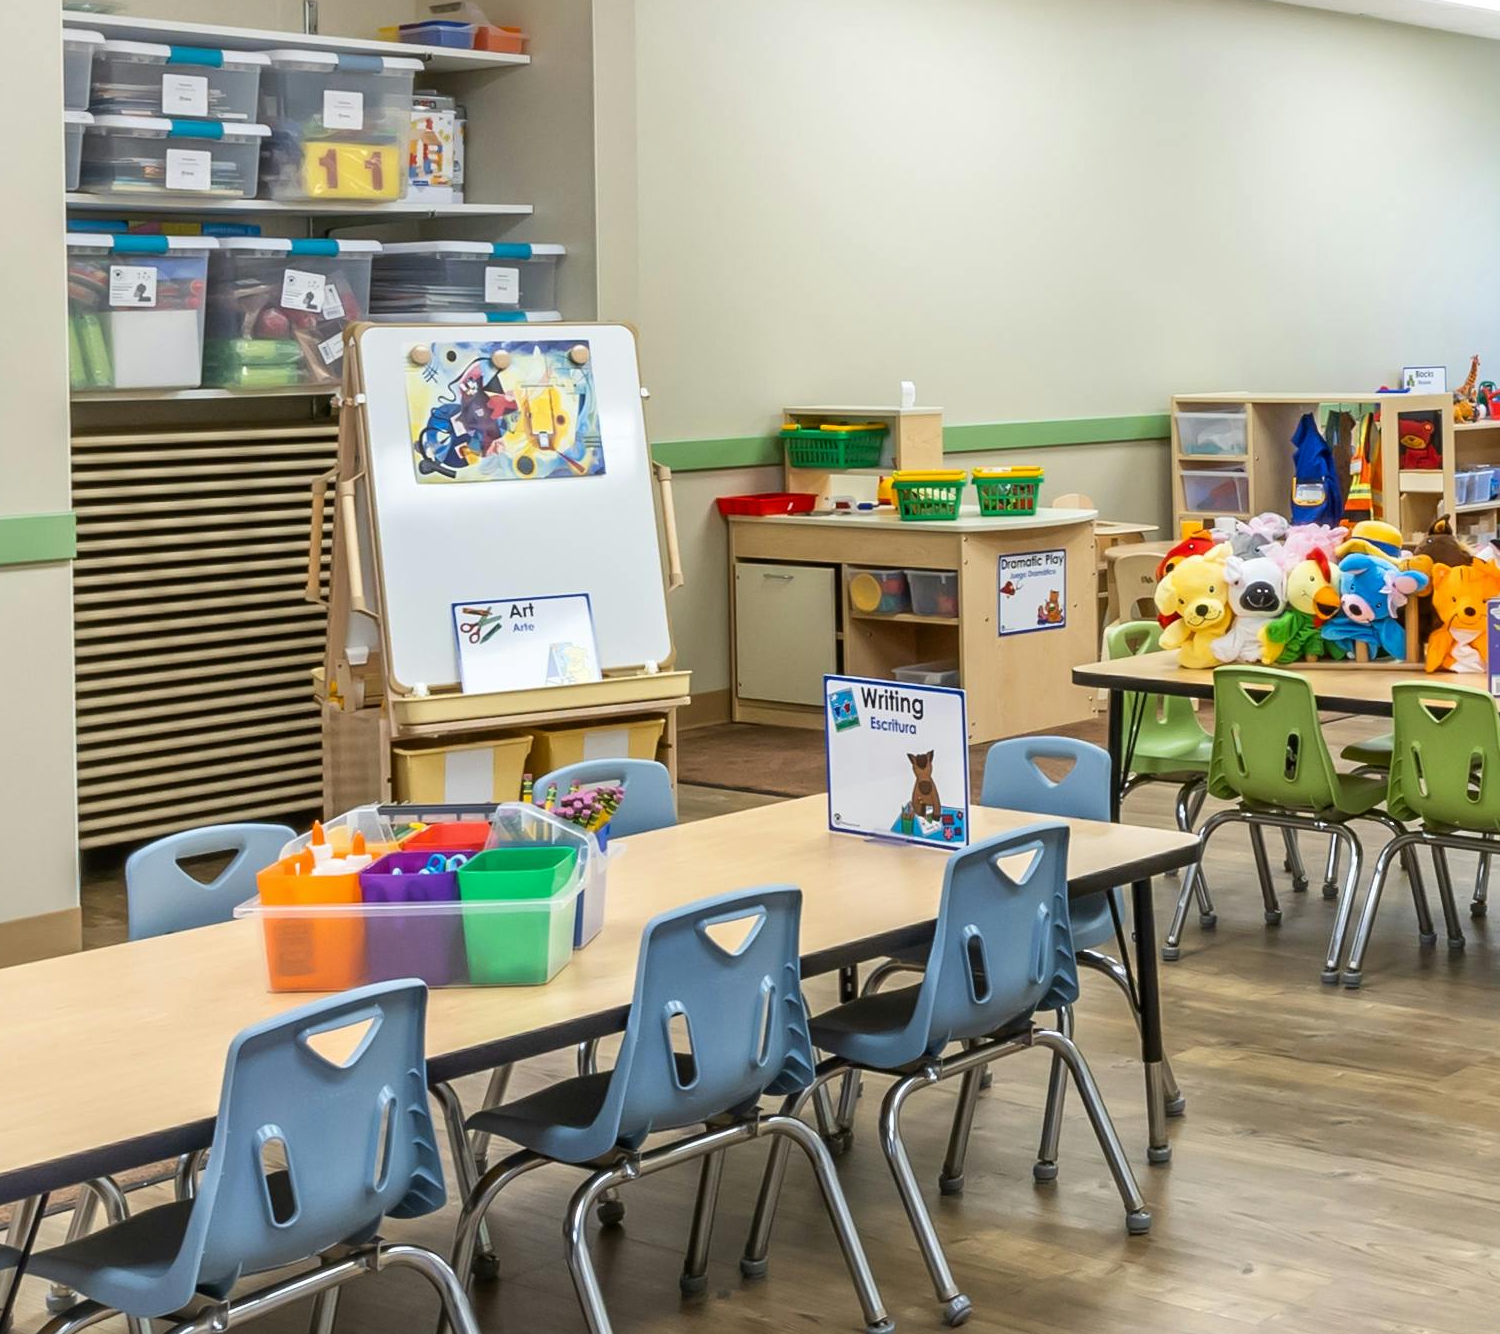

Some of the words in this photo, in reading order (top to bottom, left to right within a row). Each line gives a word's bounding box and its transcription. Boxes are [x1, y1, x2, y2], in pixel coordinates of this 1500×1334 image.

[1001, 556, 1042, 570] Dramatic
[1045, 554, 1064, 567] Play
[509, 602, 535, 619] Art
[512, 622, 535, 632] Arte
[860, 686, 924, 721] Writing
[870, 716, 917, 735] Escritura
